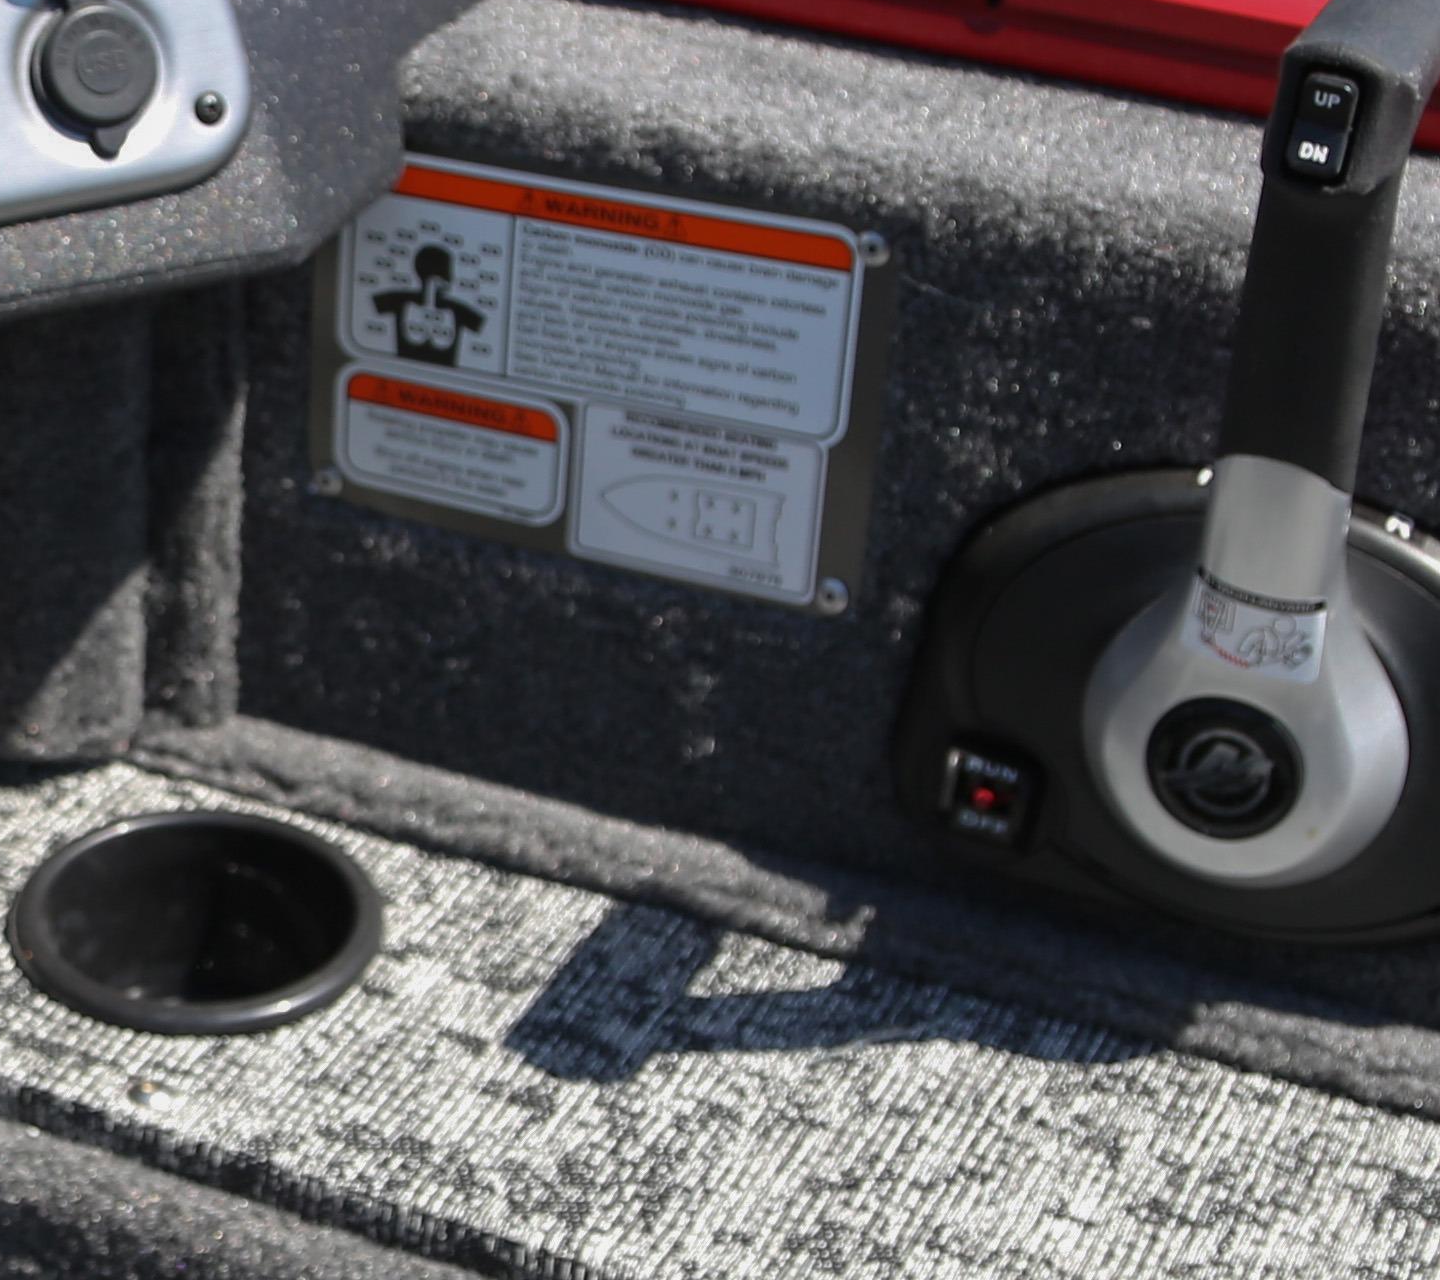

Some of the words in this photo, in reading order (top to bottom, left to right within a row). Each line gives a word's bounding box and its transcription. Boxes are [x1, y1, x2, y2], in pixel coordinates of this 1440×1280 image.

[1314, 90, 1341, 108] UP
[1298, 141, 1329, 164] DN
[544, 199, 660, 232] WARNING
[965, 755, 1018, 783] RUN
